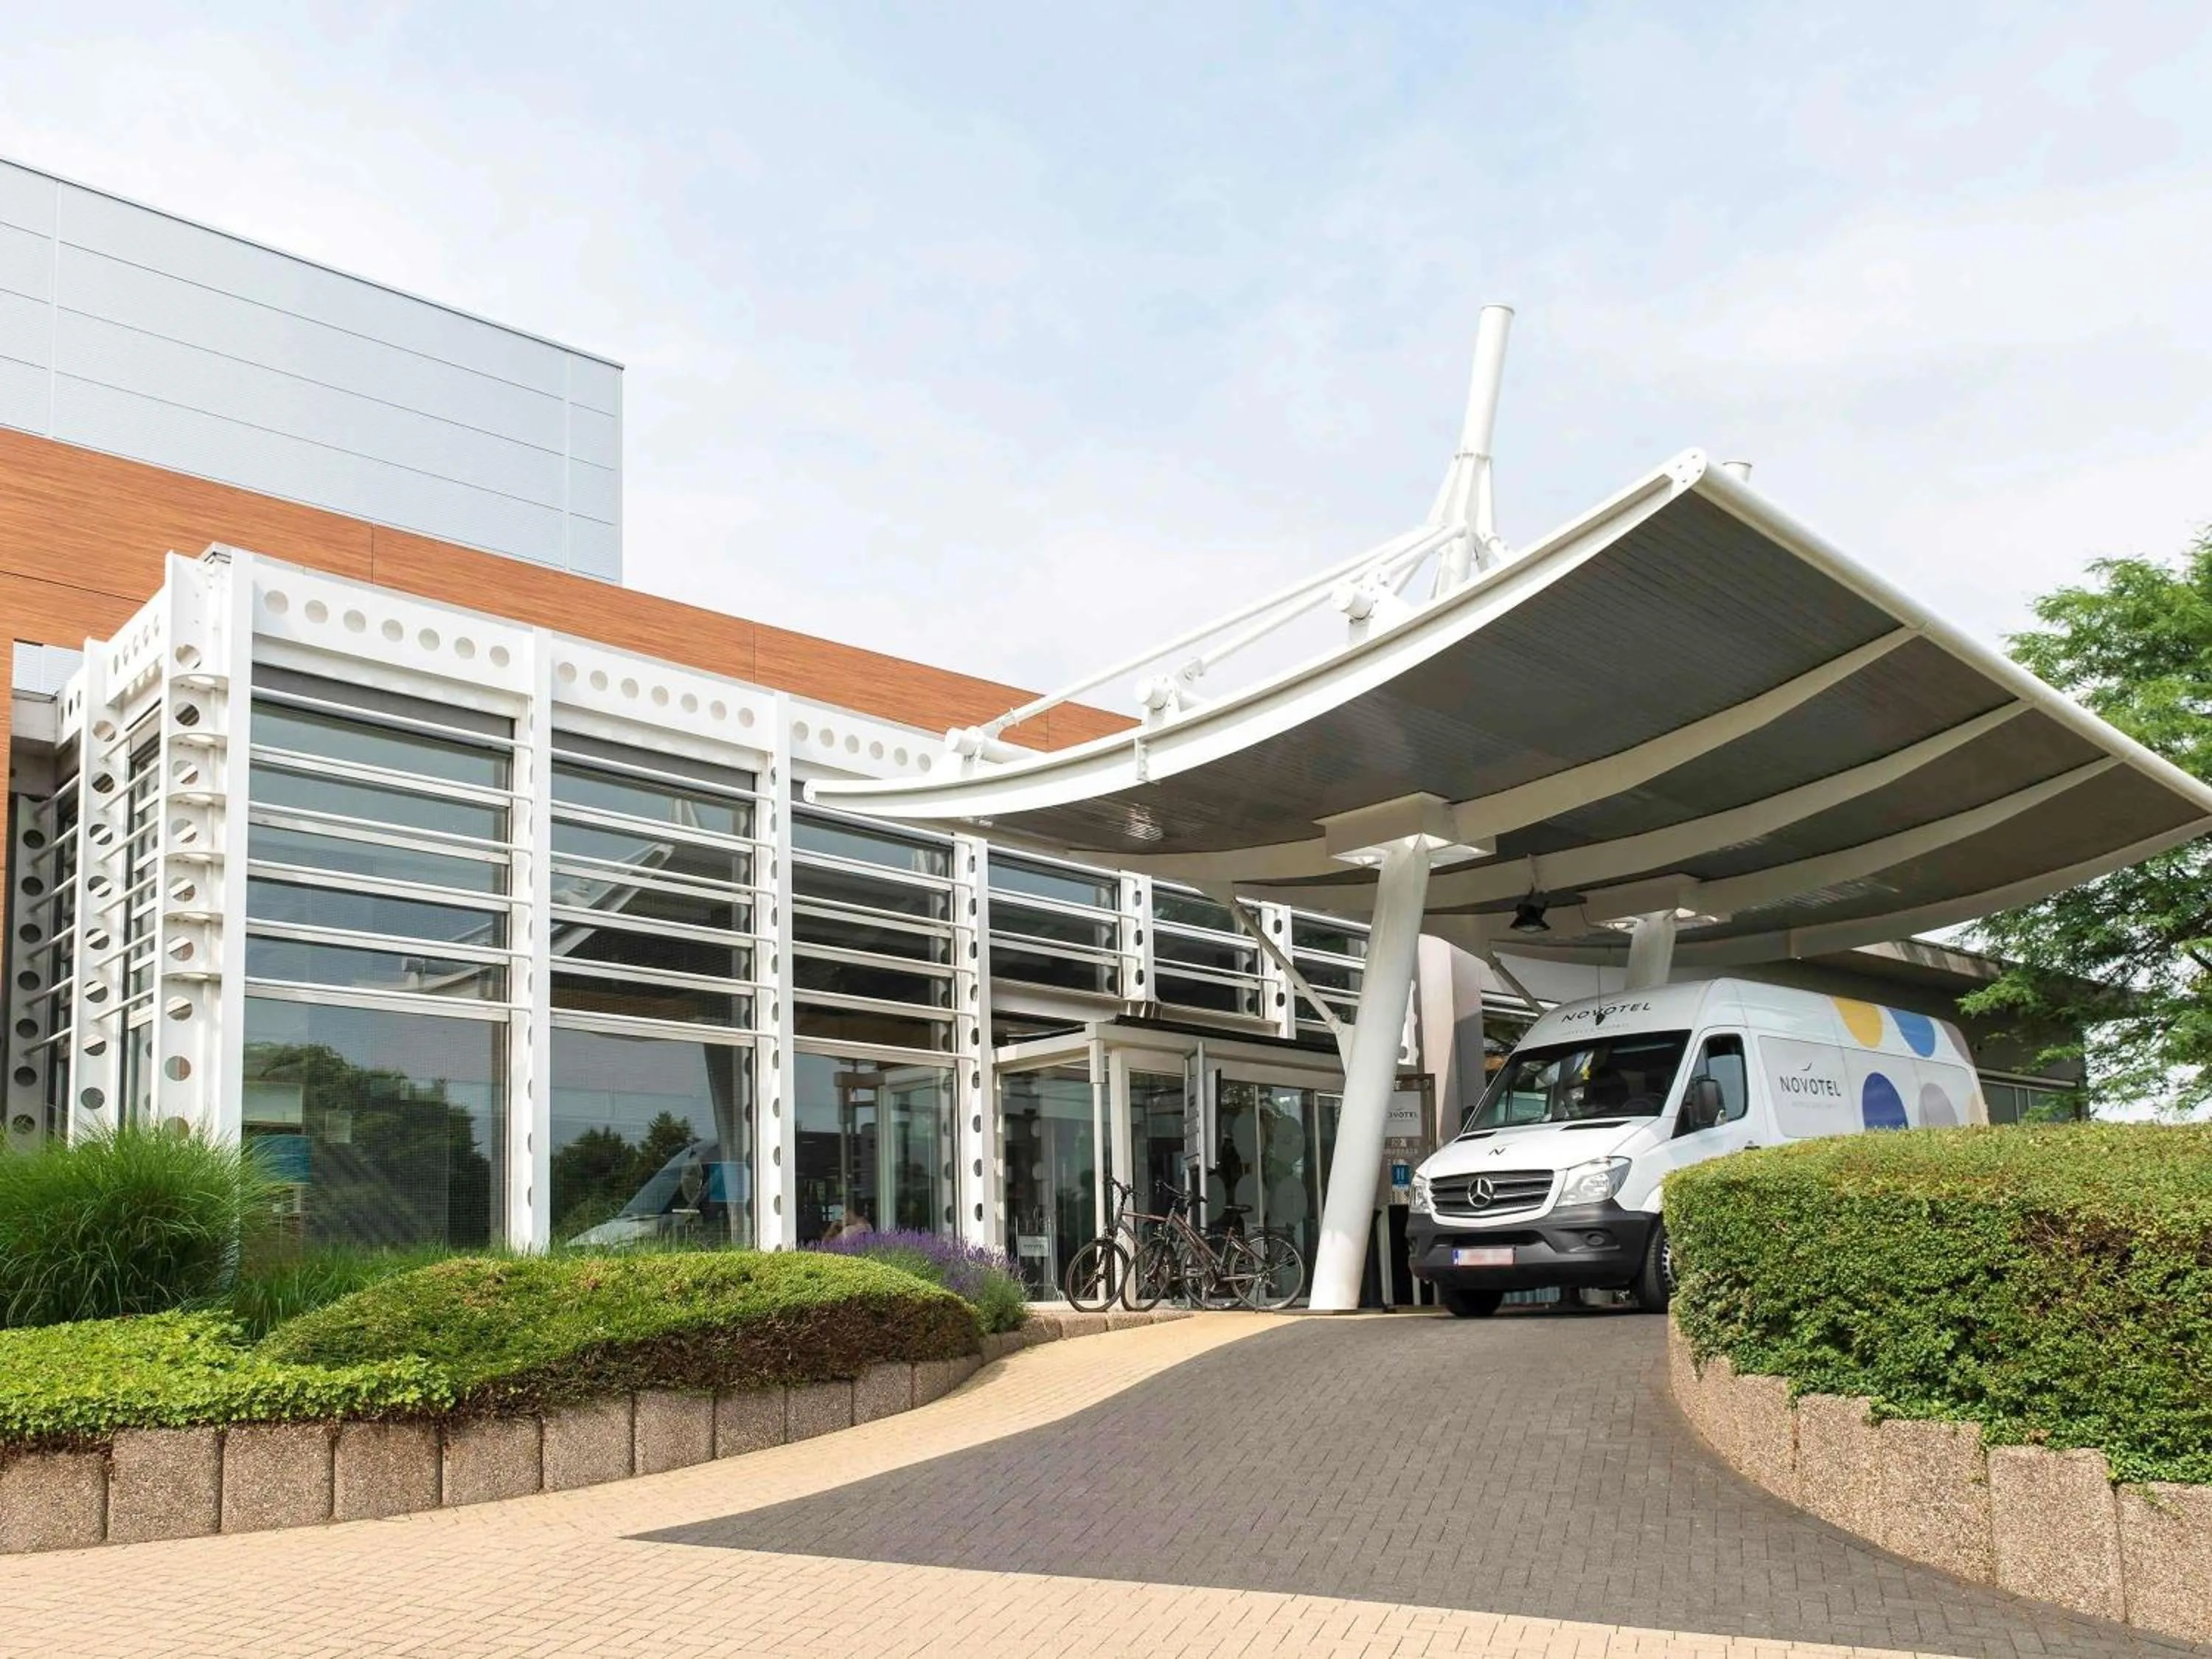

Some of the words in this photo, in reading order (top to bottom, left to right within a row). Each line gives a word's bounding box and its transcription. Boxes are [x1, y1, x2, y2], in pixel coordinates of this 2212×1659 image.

[1562, 1002, 1651, 1022] NOVOTEL
[1779, 1076, 1841, 1096] NOVOTEL
[1489, 1147, 1506, 1156] N
